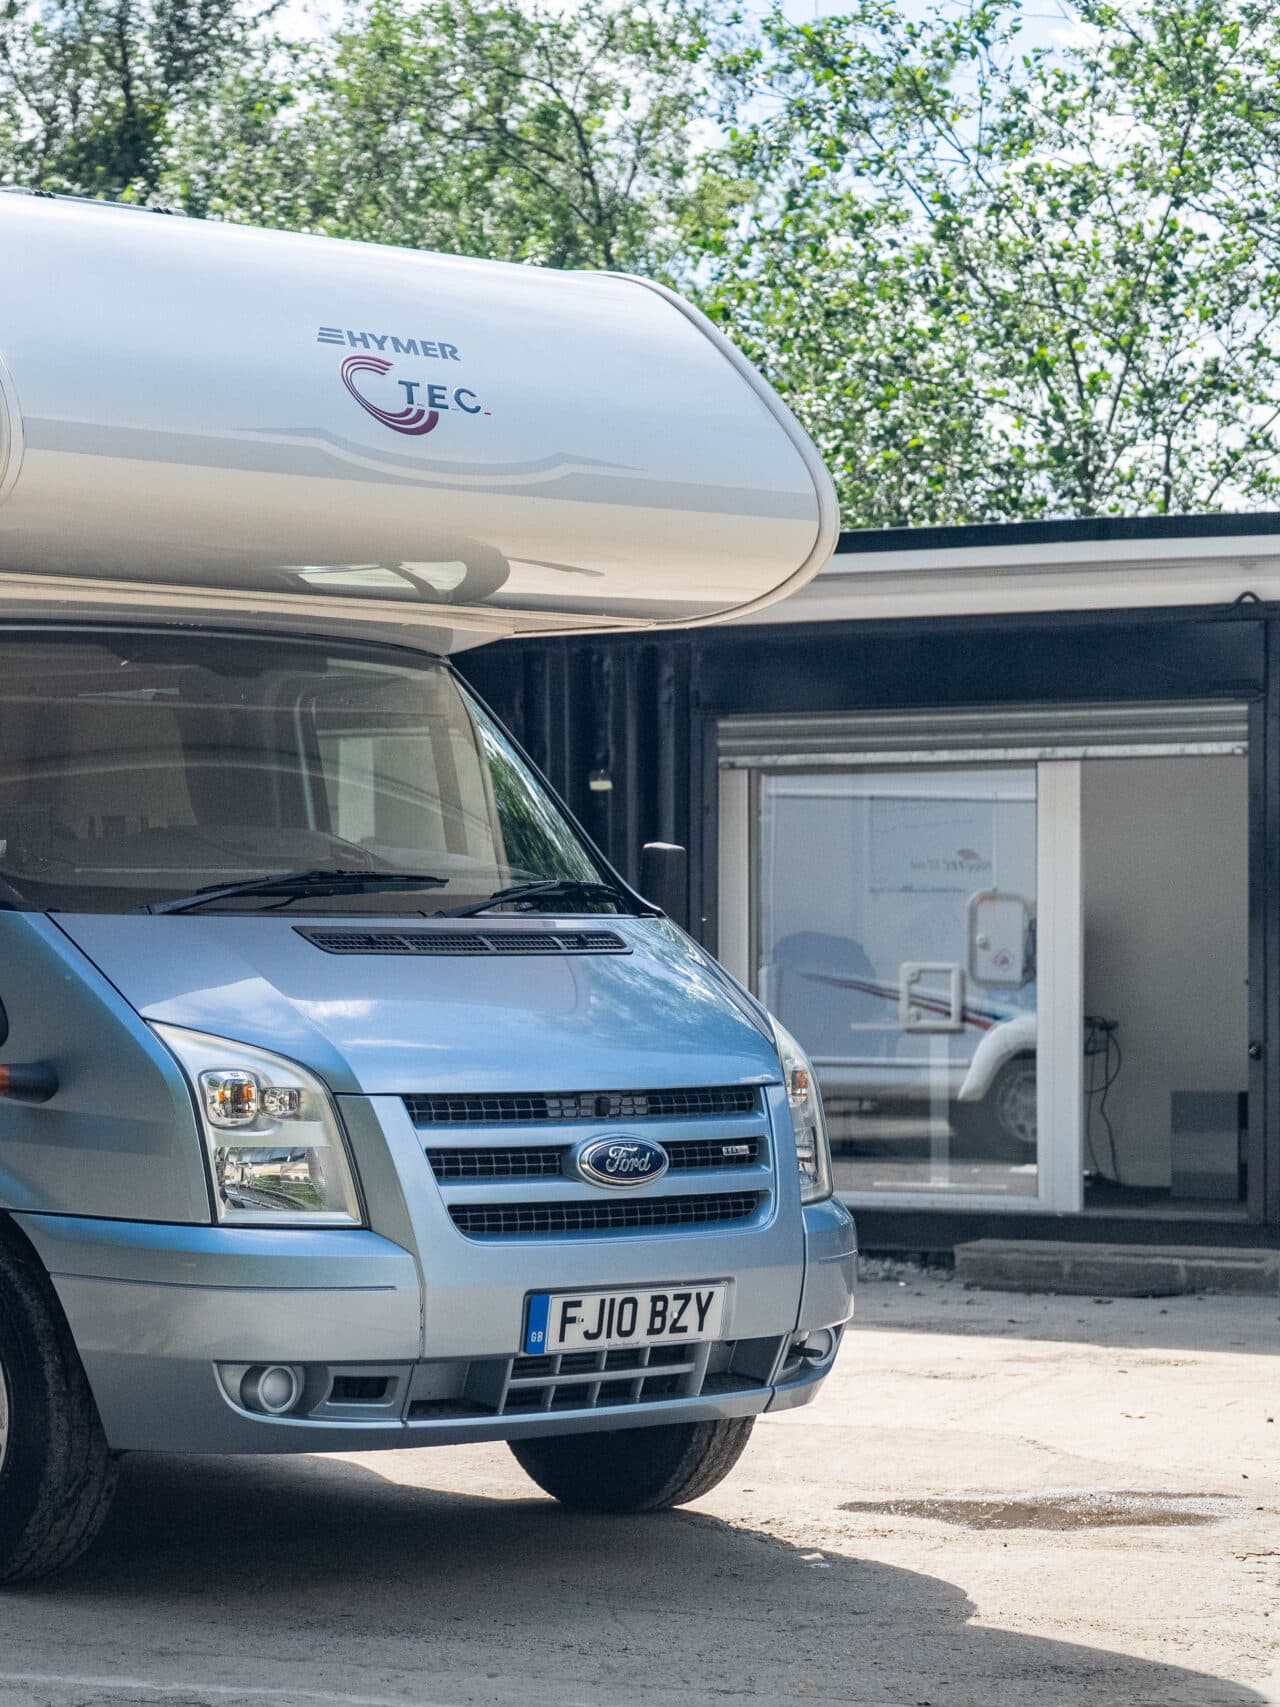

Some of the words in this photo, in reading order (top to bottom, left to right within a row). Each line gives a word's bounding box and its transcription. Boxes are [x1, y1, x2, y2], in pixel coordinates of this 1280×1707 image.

[346, 330, 461, 361] HYMER
[605, 1146, 651, 1172] Ford
[558, 1296, 638, 1343] FJ10
[646, 1291, 715, 1336] BZY
[530, 1330, 544, 1343] GB
